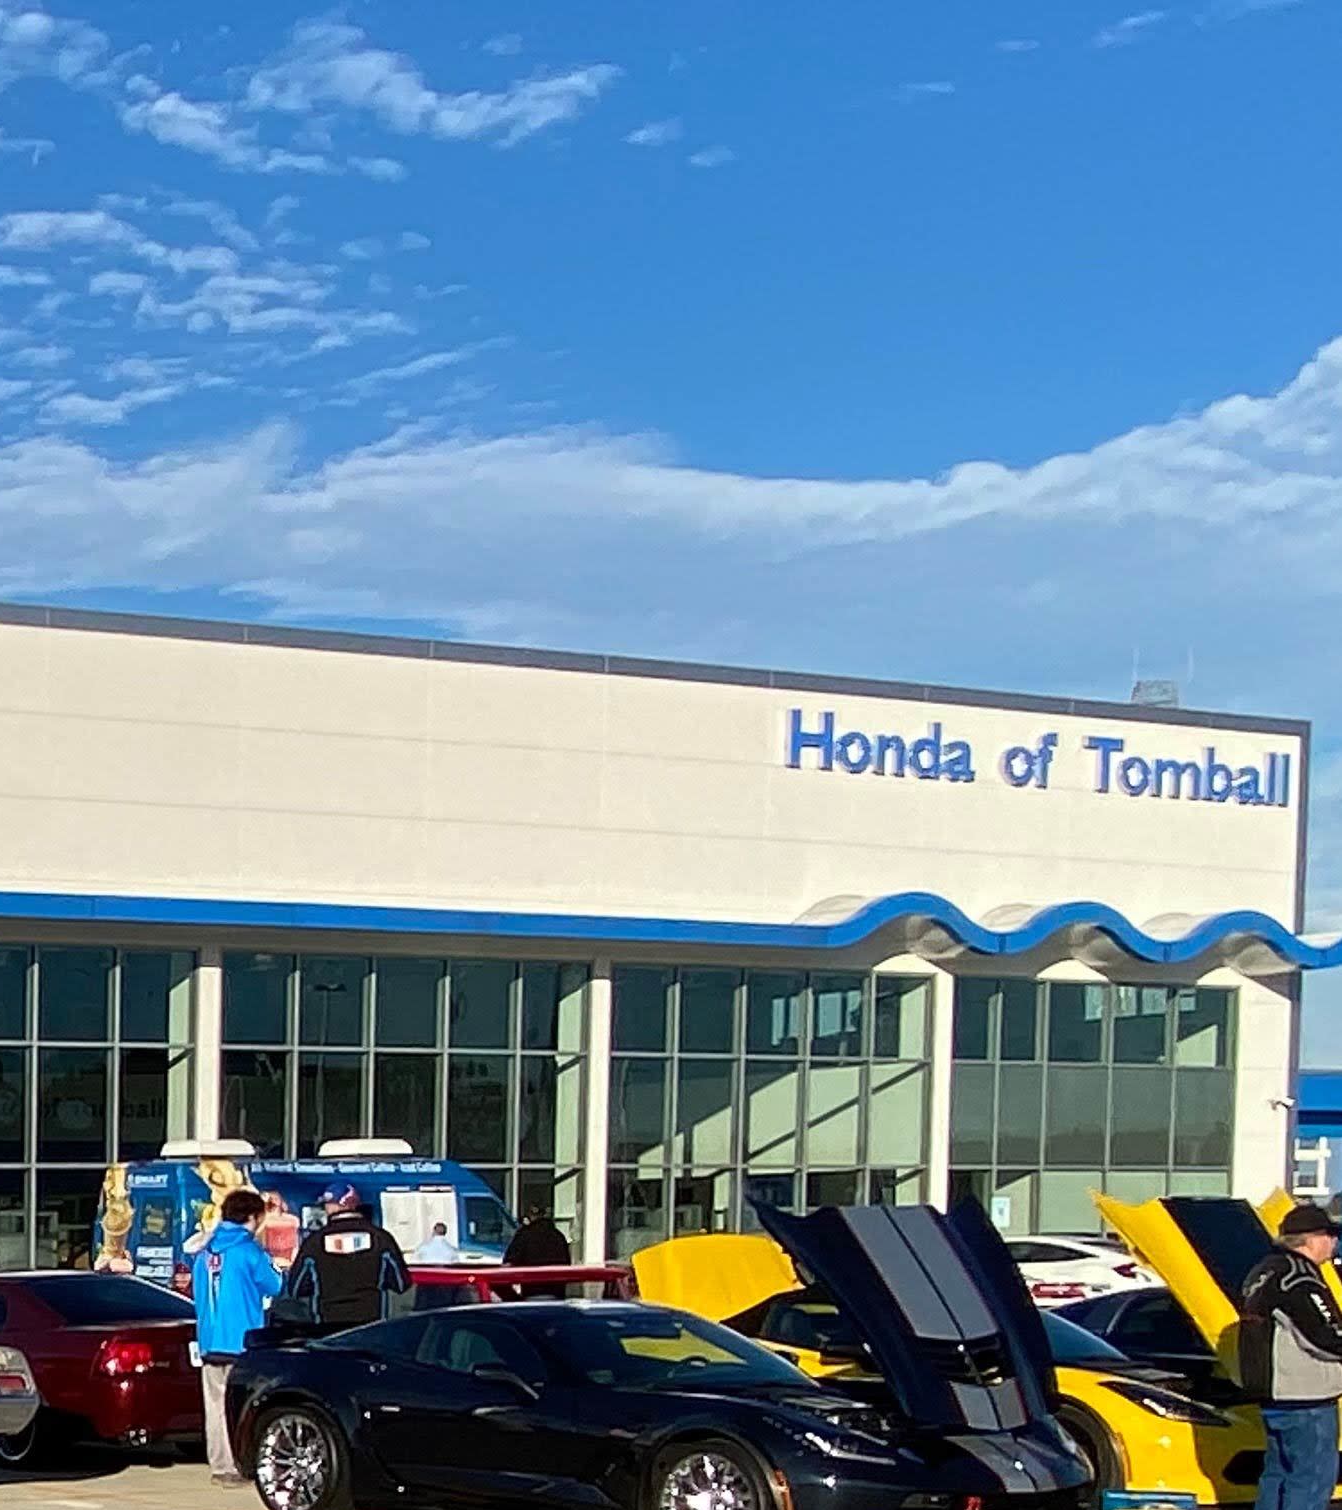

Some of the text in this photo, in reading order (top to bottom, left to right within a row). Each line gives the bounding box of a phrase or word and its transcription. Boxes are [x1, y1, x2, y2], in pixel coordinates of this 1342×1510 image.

[785, 708, 1291, 807] Honda of Tomball
